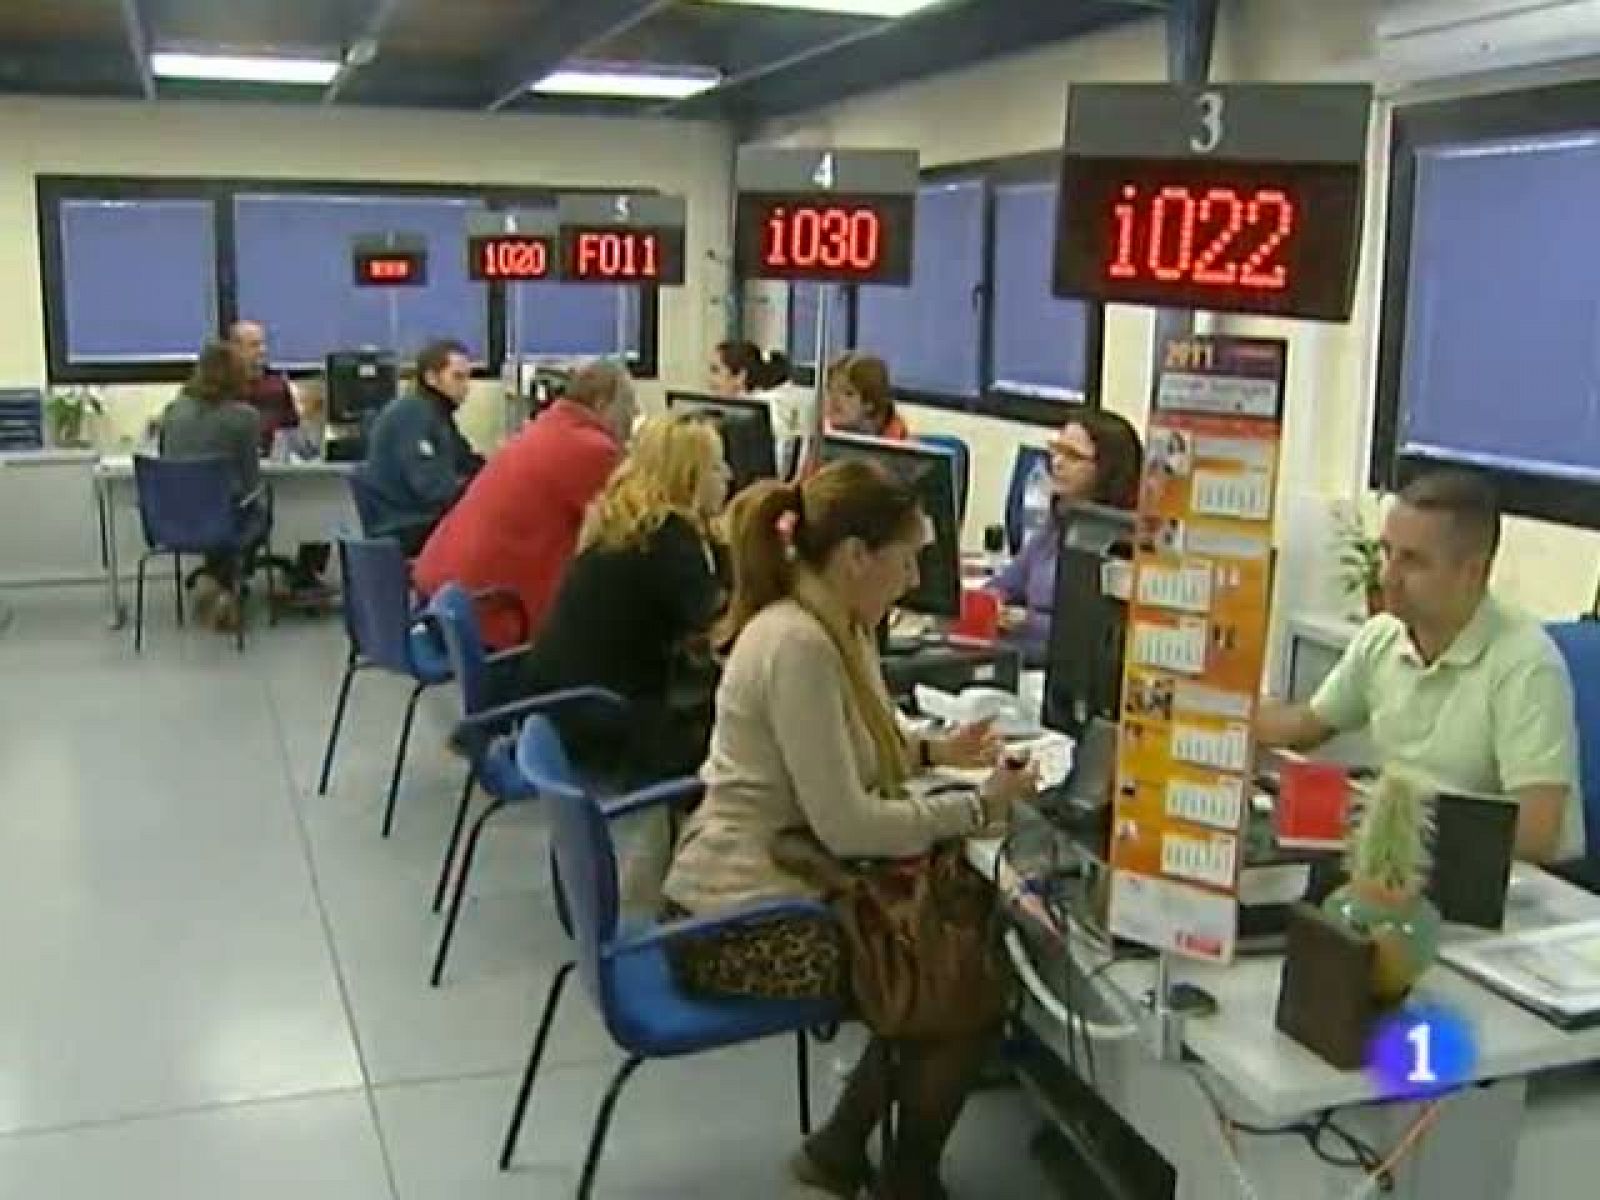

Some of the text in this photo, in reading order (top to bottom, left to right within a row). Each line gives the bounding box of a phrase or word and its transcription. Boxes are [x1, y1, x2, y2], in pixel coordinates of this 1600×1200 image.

[1190, 93, 1223, 153] 3
[812, 152, 834, 190] 4
[579, 233, 656, 276] F011
